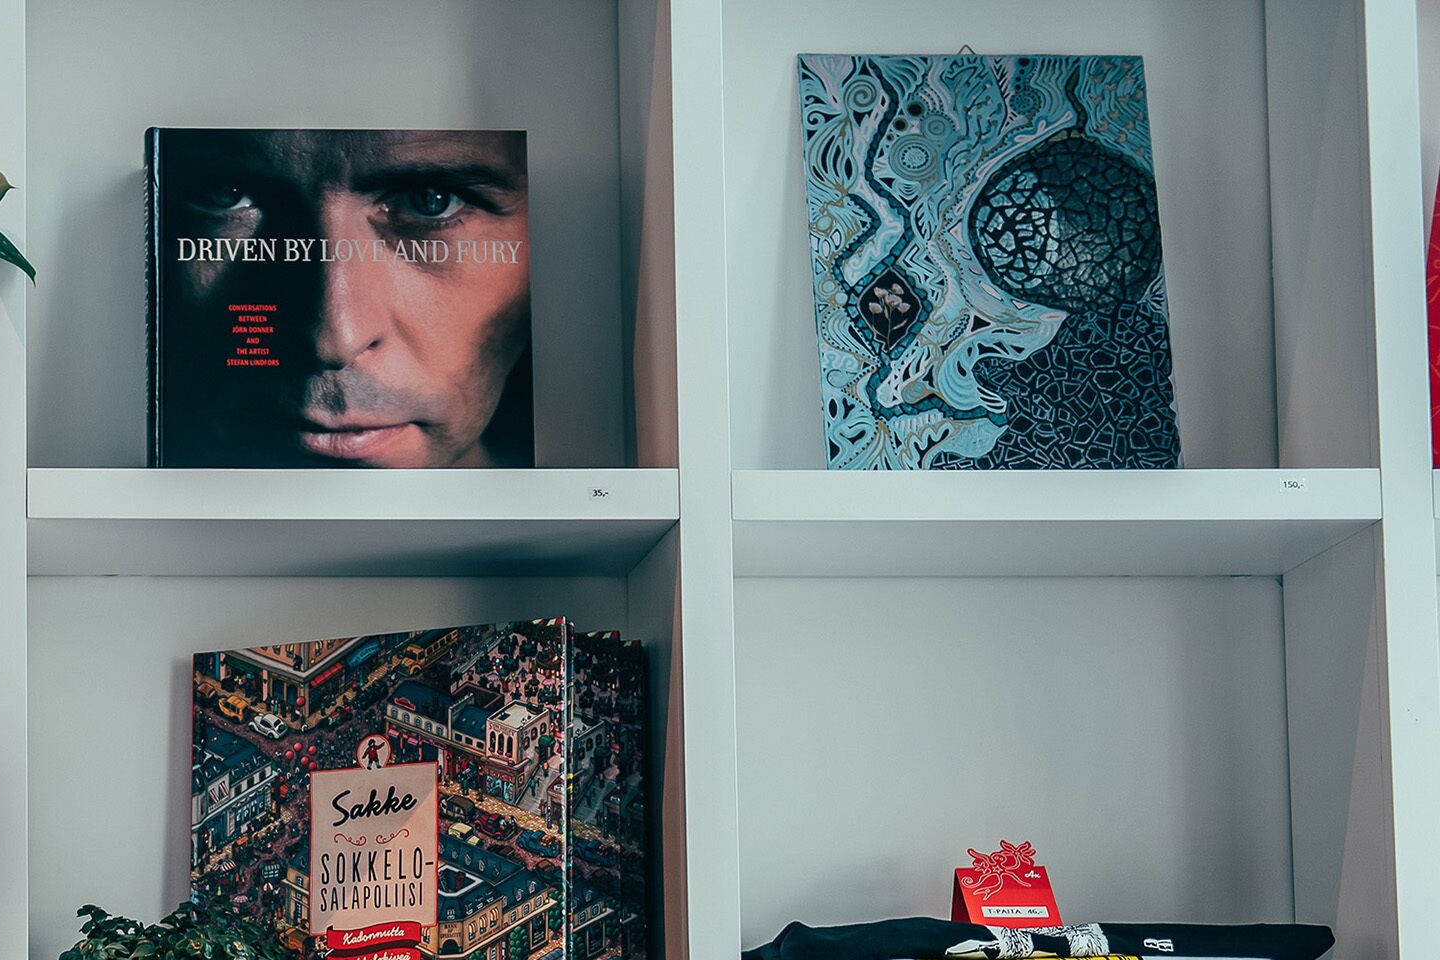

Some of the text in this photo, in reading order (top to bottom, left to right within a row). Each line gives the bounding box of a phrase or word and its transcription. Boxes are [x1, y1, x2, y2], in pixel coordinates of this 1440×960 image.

[177, 238, 522, 265] DRIVEN BY LOVE AND FURY
[331, 786, 417, 827] Sakke
[320, 847, 434, 885] SOKKELO-
[320, 882, 423, 912] SALAPOLIISI
[342, 927, 405, 946] Kadonnutta
